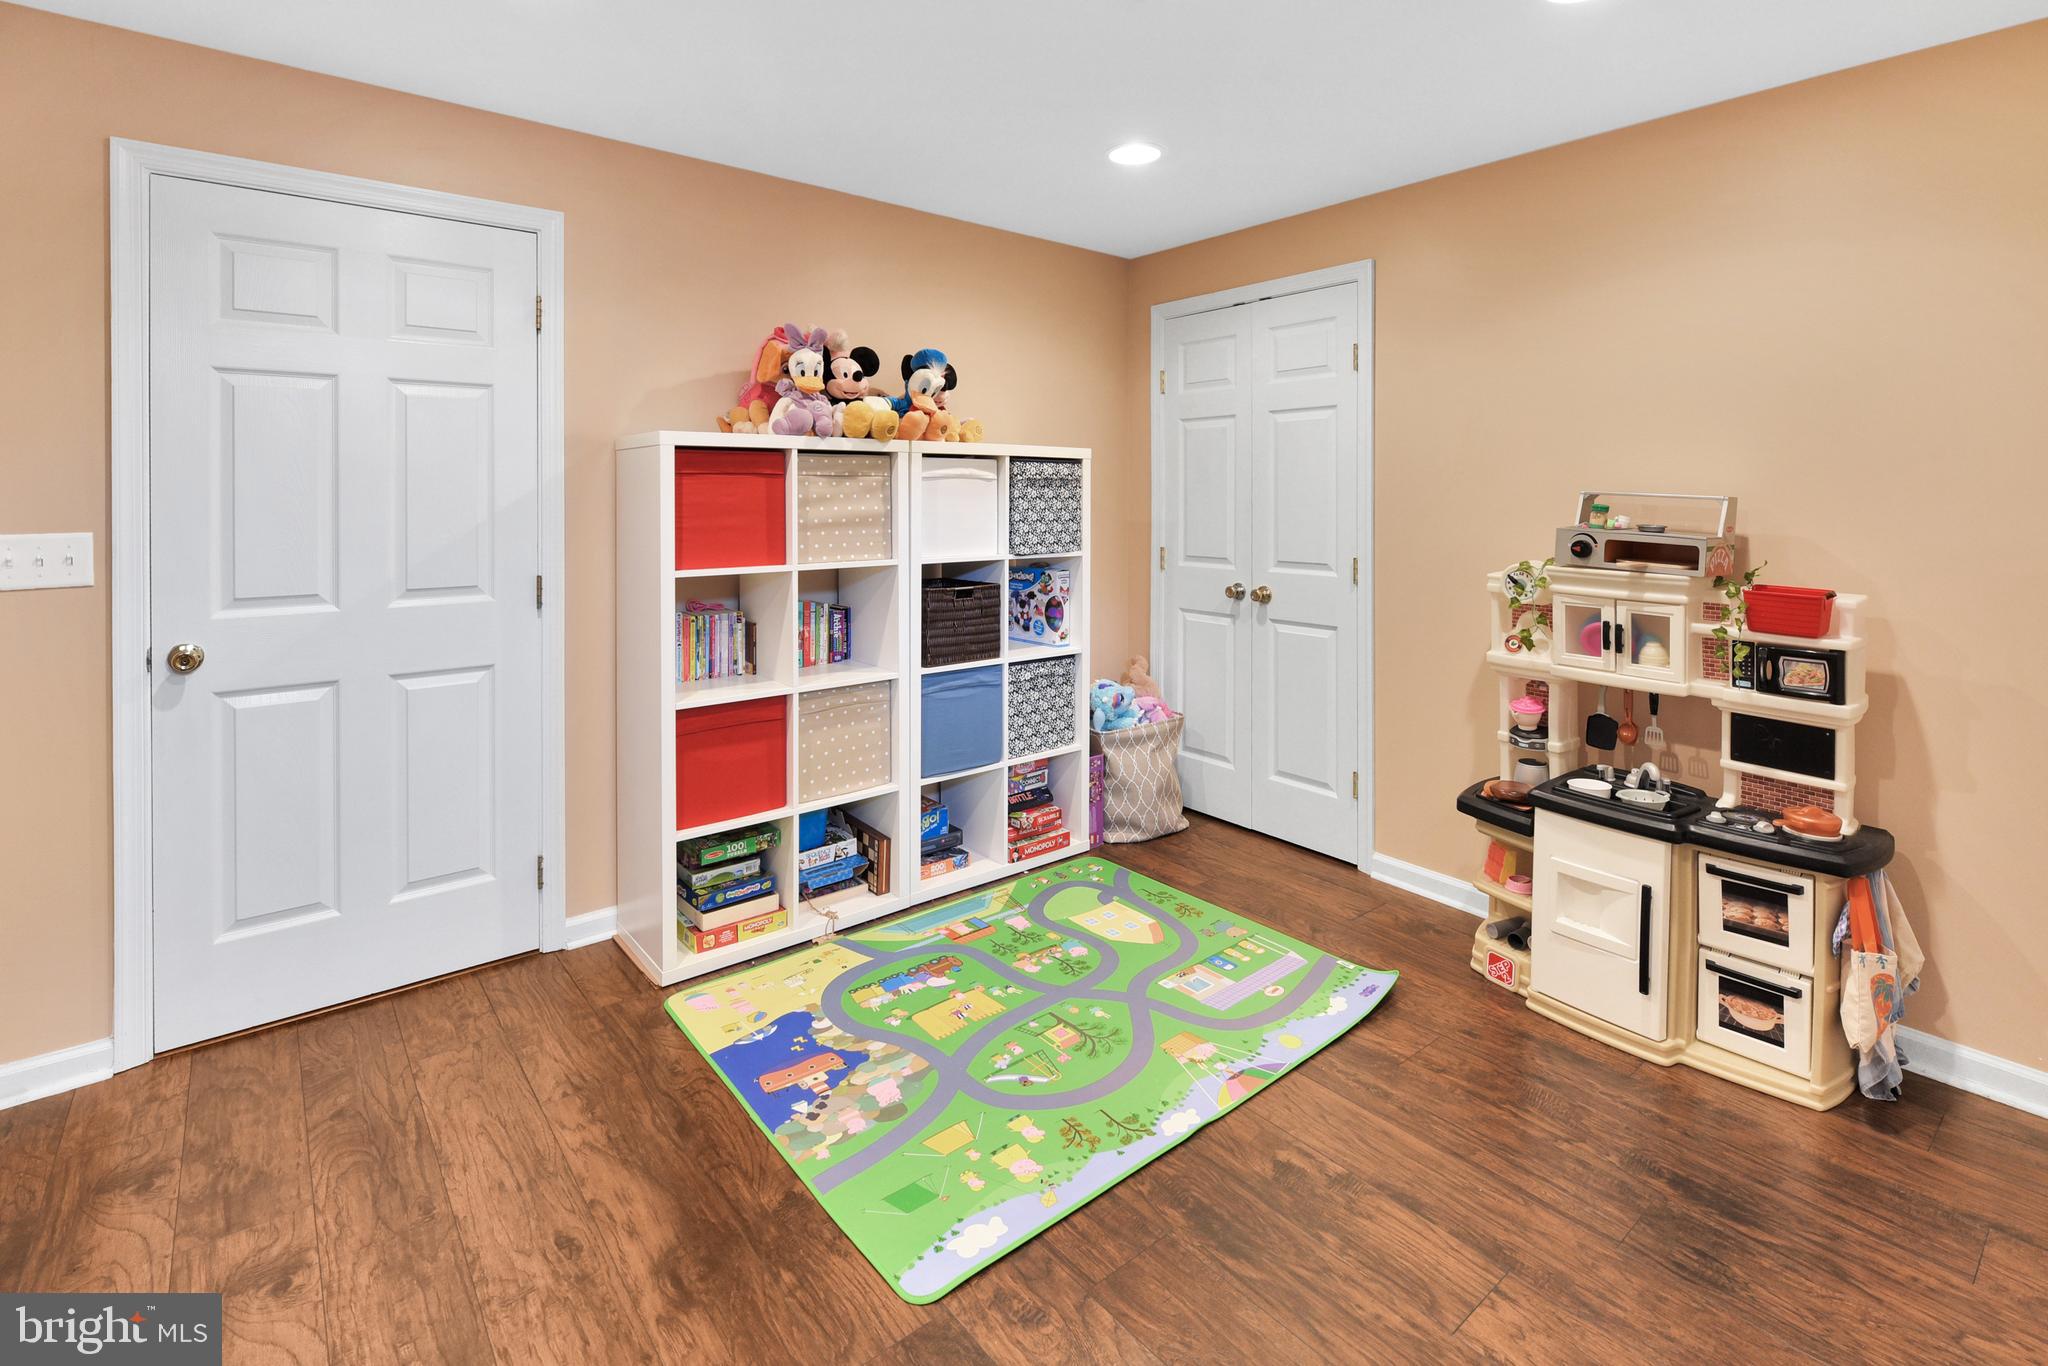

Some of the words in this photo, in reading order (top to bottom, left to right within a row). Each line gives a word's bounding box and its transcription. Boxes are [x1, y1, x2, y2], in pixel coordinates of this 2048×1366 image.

[1710, 548, 1729, 573] PIZZA
[833, 613, 842, 638] Archie
[1024, 839, 1056, 855] MONOPOLY
[744, 917, 773, 931] MONOPOLY
[1488, 960, 1511, 977] STEP
[1501, 971, 1512, 984] 2
